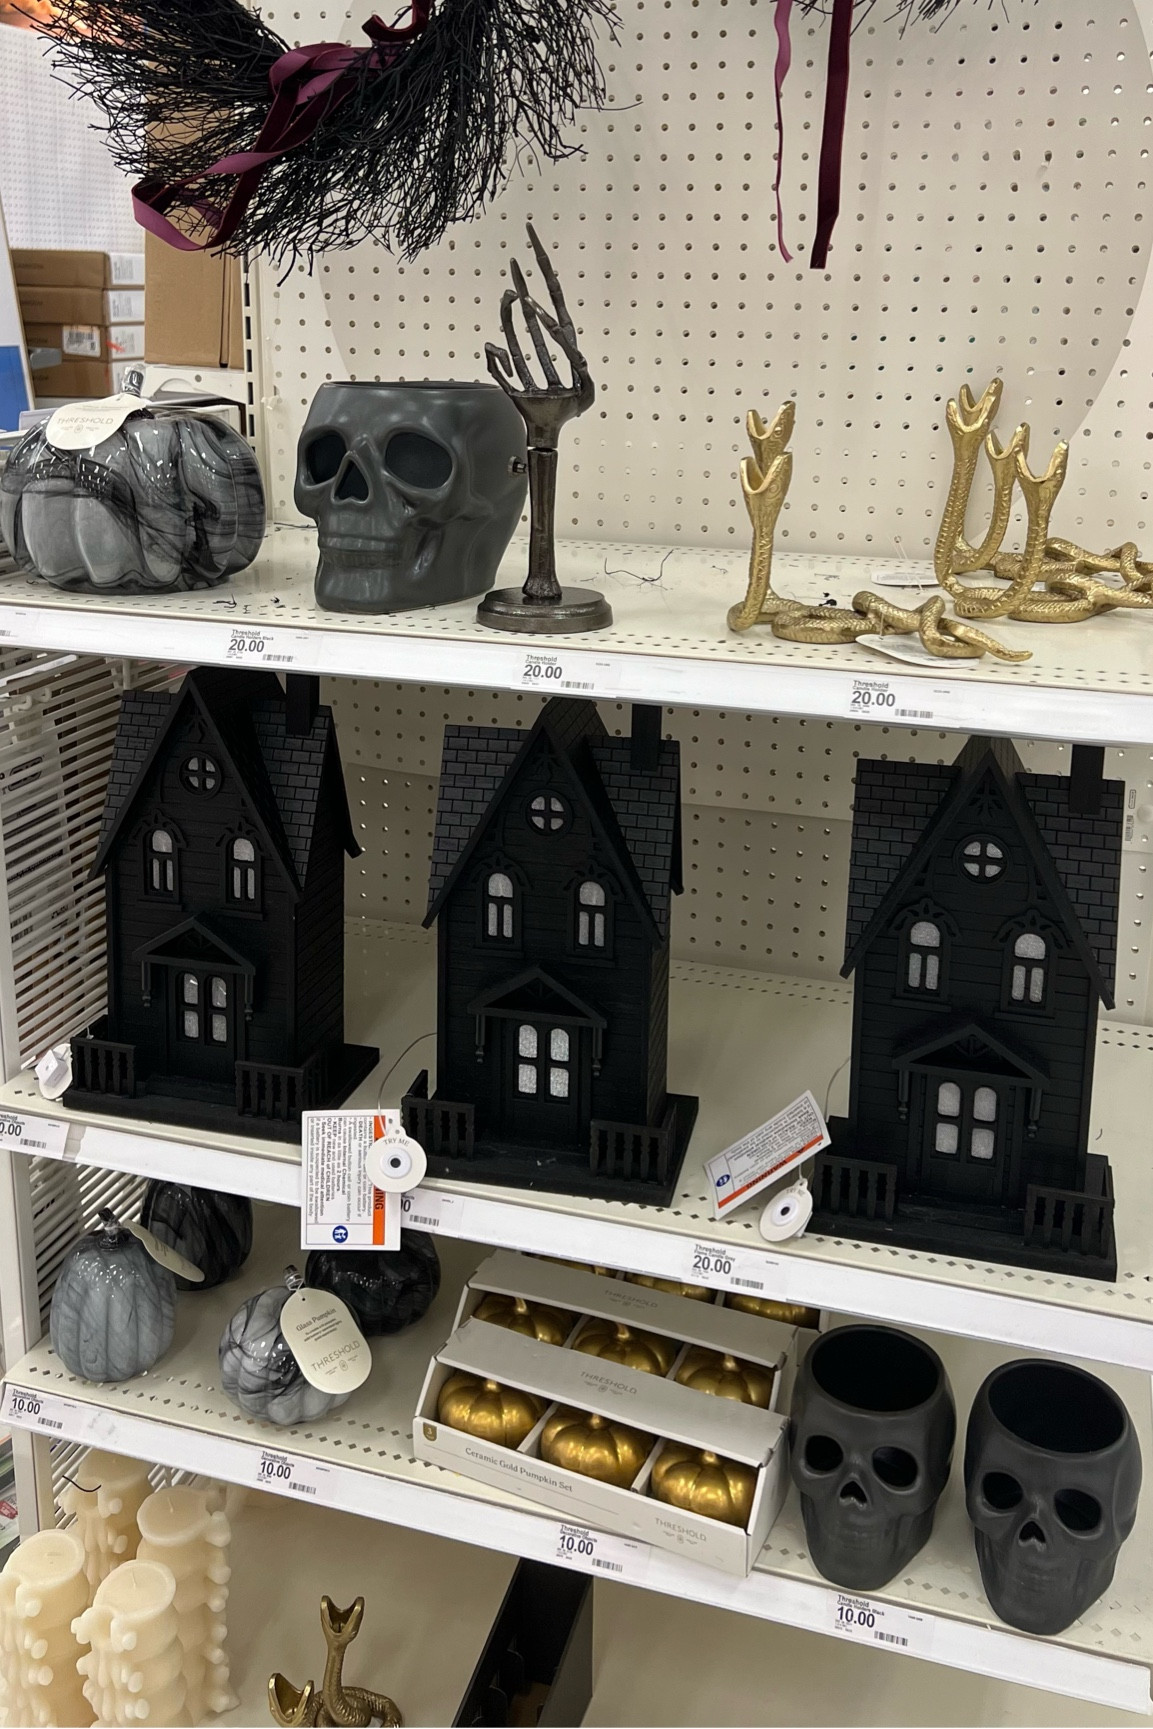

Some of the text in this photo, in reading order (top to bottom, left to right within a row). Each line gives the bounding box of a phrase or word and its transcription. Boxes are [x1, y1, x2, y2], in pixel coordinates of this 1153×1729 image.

[229, 639, 264, 652] 20.00
[524, 664, 562, 679] 20.00
[852, 690, 895, 706] 20.00
[398, 1138, 410, 1147] ME
[746, 1160, 788, 1189] WARNING
[696, 1244, 726, 1255] Threshold
[693, 1255, 731, 1274] 20.00
[605, 1290, 658, 1308] THRESHOLD
[296, 1320, 313, 1331] Glass
[312, 1308, 336, 1323] Pumpkin
[312, 1340, 360, 1371] THRESHOLD
[580, 1371, 637, 1394] THRESHOLD
[13, 1388, 37, 1399] Threshold
[12, 1397, 40, 1414] 10.00
[262, 1451, 287, 1461] Threshold
[260, 1461, 291, 1479] 10.00
[465, 1448, 573, 1492] Ceramic Gold Pumpkin Set
[561, 1524, 589, 1536] Threshold
[655, 1518, 707, 1541] THRESHOLD
[559, 1535, 594, 1555] 10.00
[838, 1594, 869, 1608] Threshold
[837, 1606, 875, 1628] 10.00
